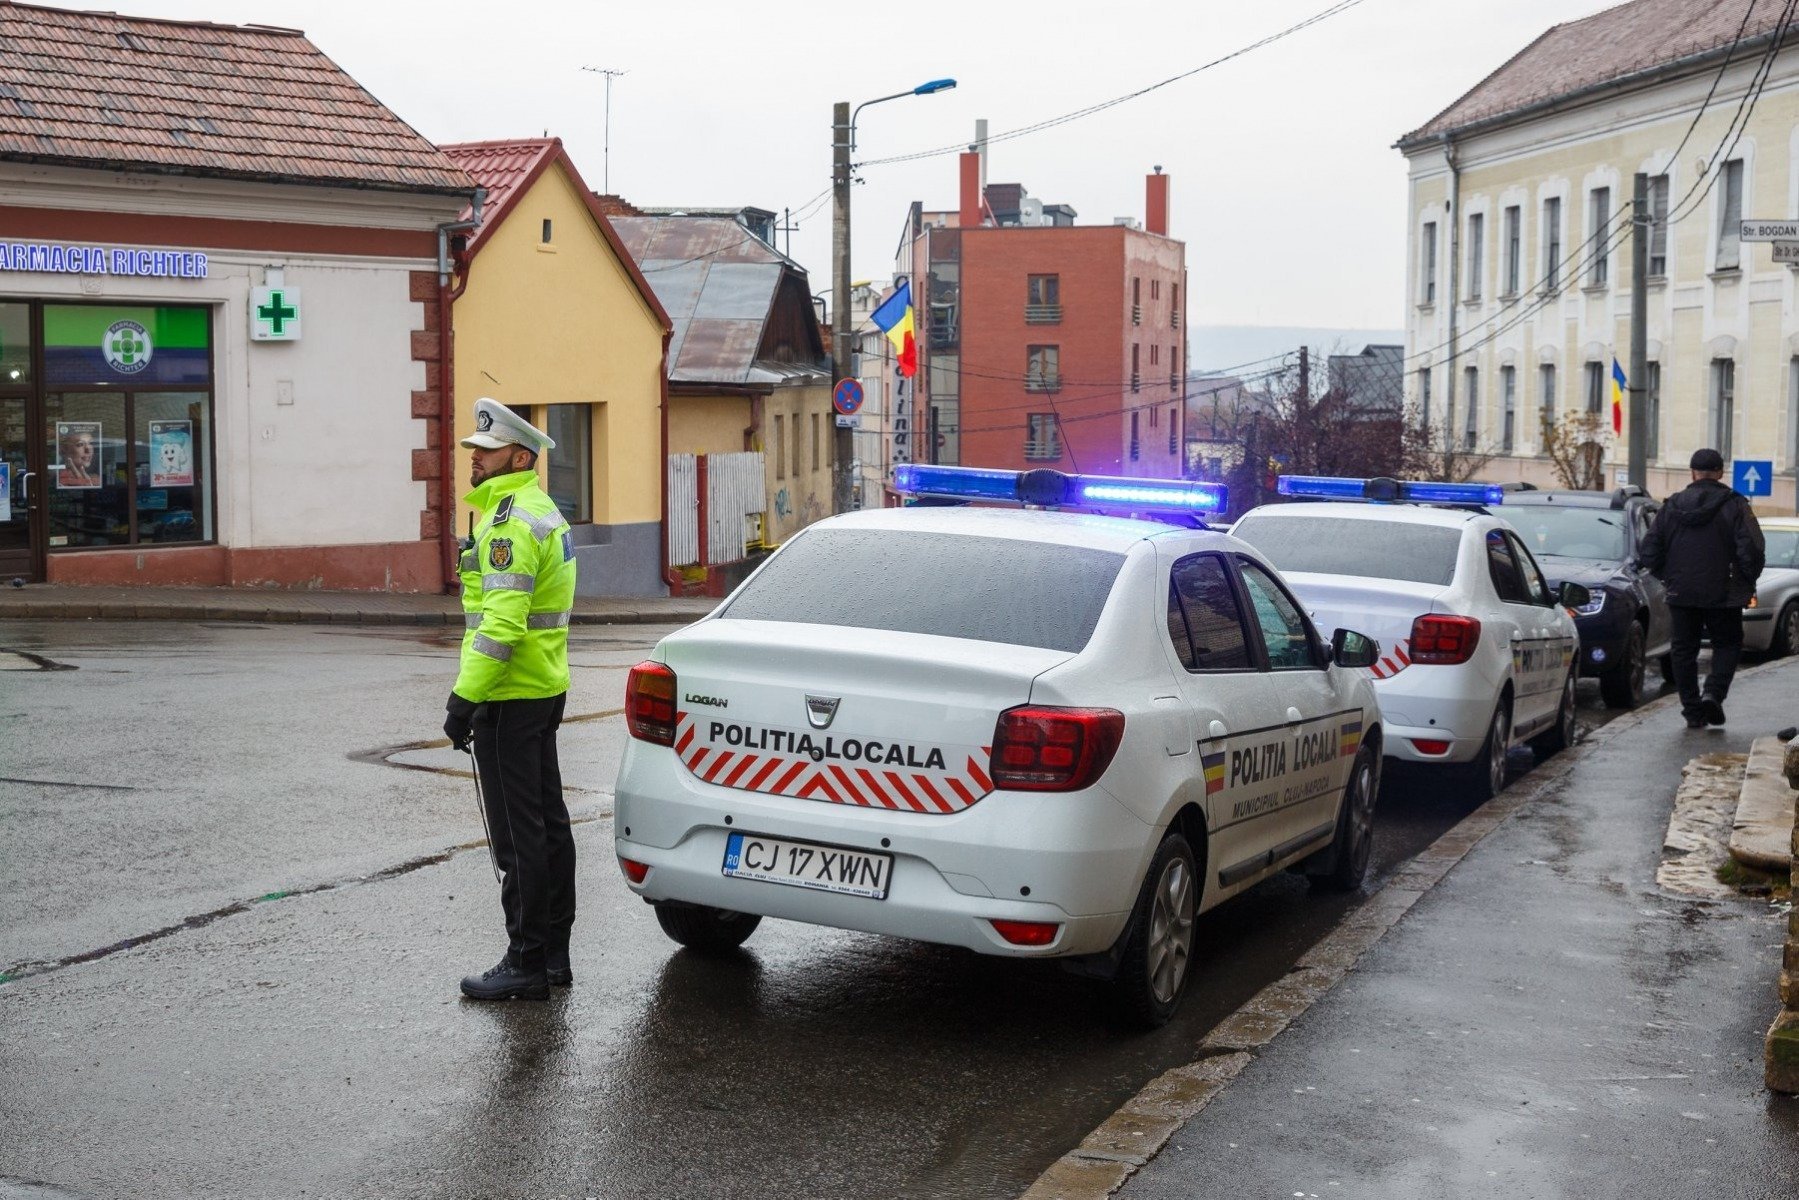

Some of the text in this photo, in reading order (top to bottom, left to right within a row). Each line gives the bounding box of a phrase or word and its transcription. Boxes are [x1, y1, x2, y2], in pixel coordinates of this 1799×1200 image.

[1758, 226, 1797, 236] BOGDAN
[111, 248, 208, 278] RICHTER
[112, 360, 143, 372] RICHTER
[685, 693, 728, 708] LOGAN
[709, 721, 947, 770] POLITIA LOCALA
[1230, 728, 1337, 788] POLITIA LOCALA
[726, 854, 739, 866] RO
[744, 841, 883, 888] CJ 17 XWN
